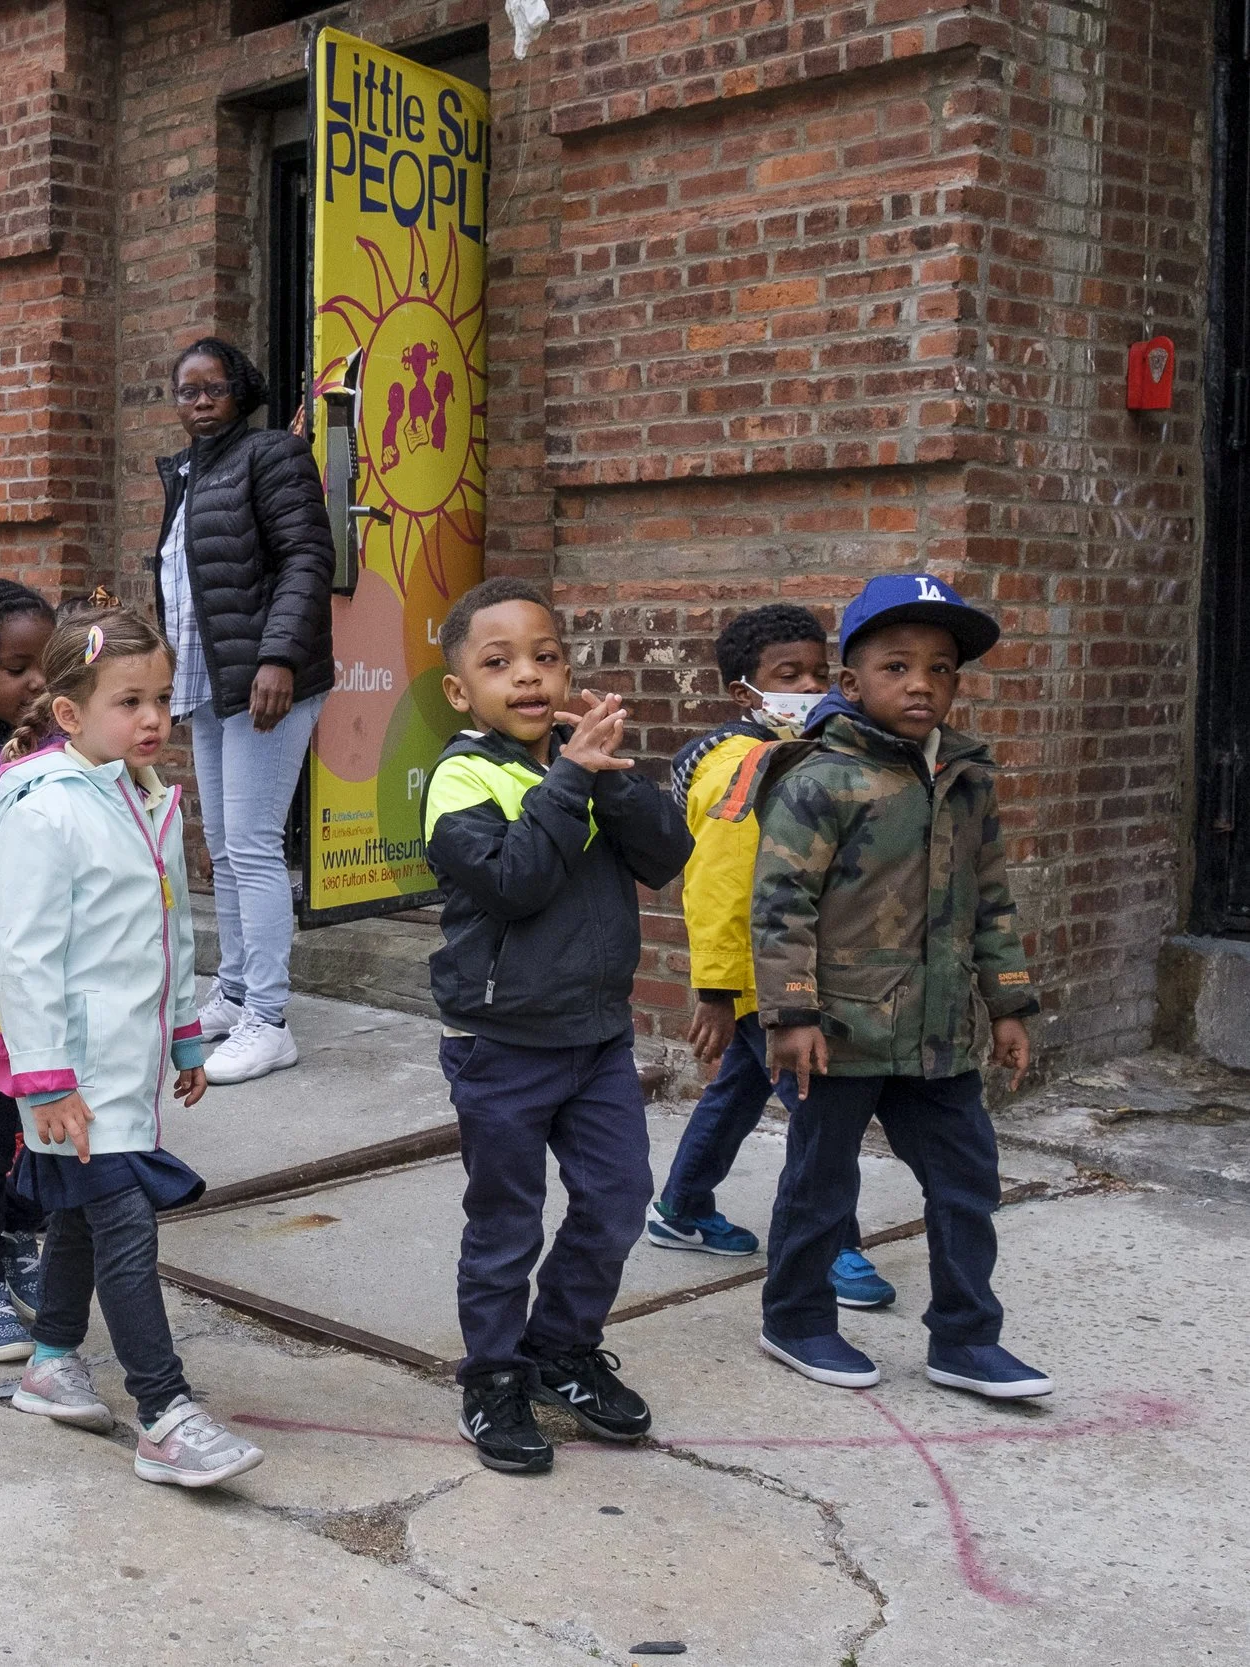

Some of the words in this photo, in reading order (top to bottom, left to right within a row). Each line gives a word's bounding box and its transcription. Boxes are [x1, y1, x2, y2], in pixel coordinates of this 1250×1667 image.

[326, 42, 425, 143] Little
[438, 88, 491, 170] Su
[915, 577, 946, 601] LA
[333, 661, 393, 692] Culture
[342, 872, 366, 888] Fulton
[557, 1380, 595, 1404] N
[470, 1410, 491, 1436] N
